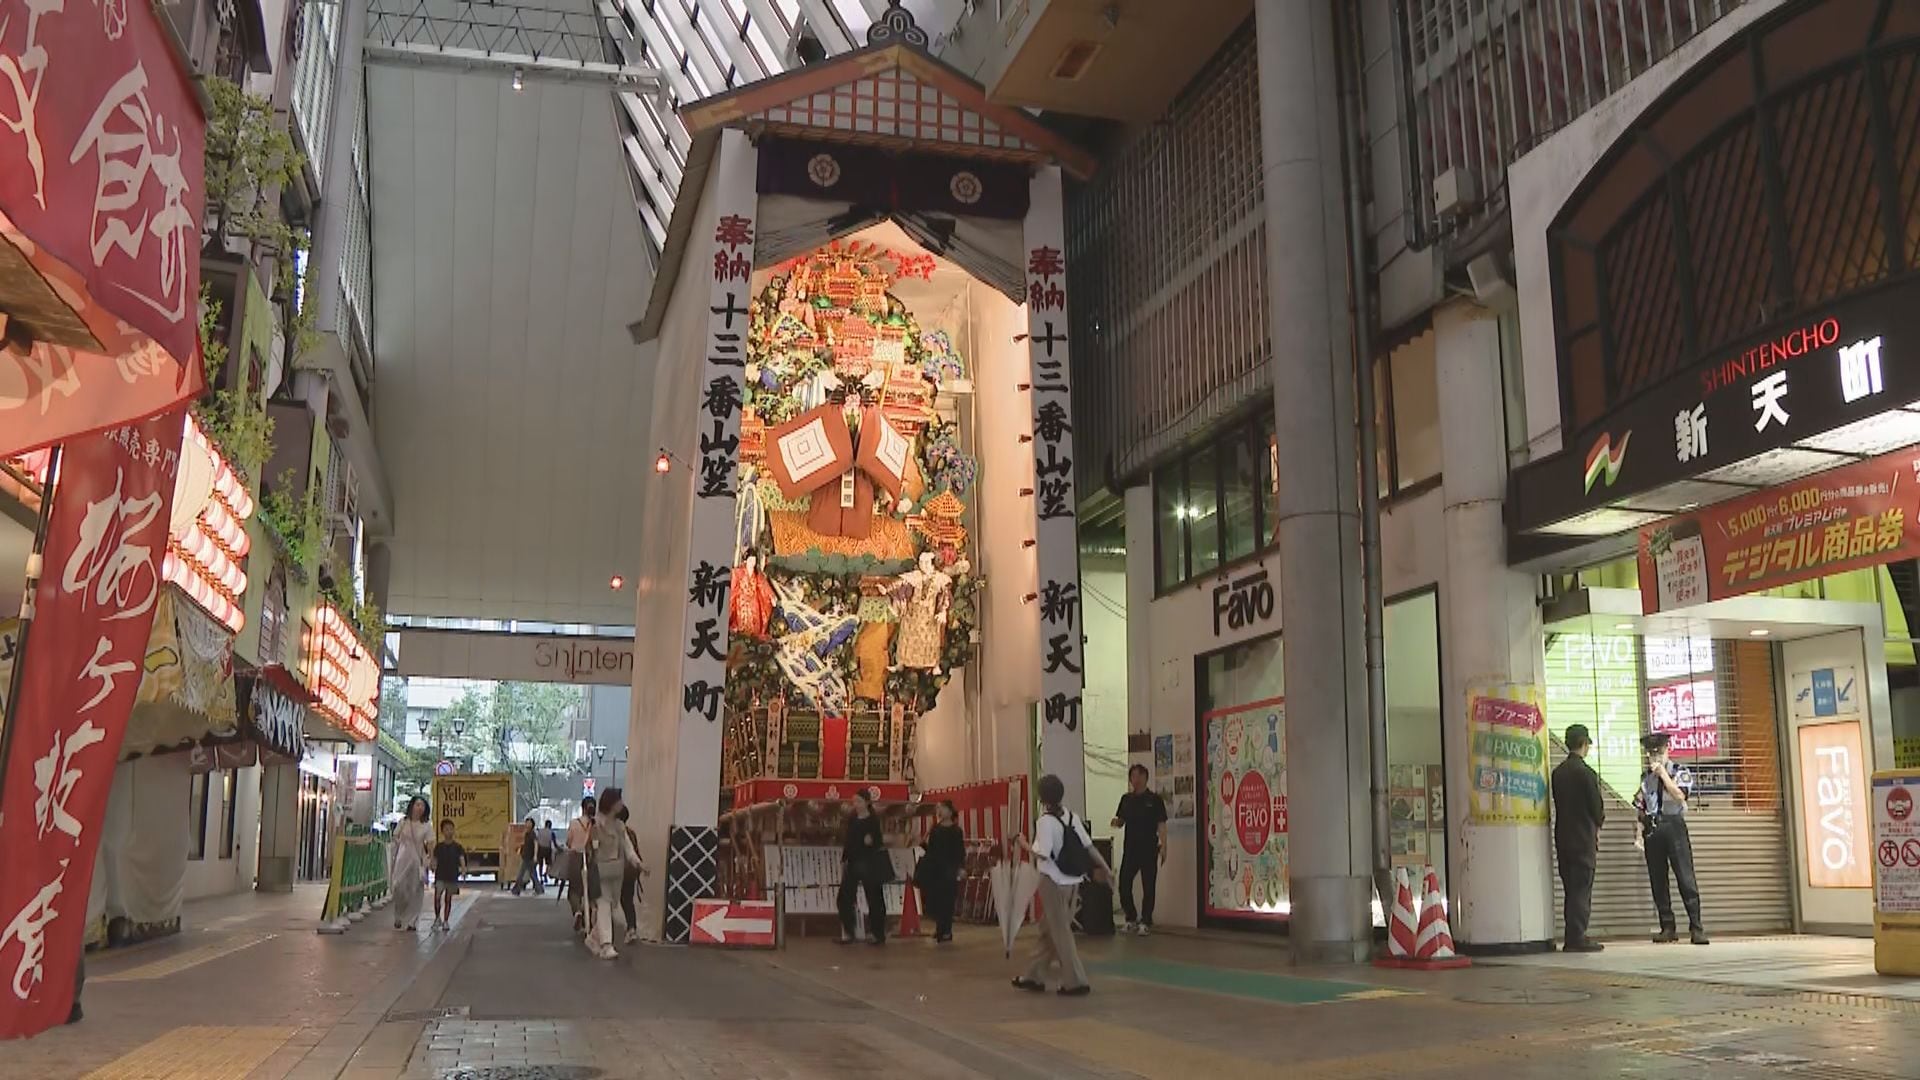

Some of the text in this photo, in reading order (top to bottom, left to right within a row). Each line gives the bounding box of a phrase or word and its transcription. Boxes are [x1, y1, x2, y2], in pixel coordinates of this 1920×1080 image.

[1702, 317, 1839, 394] SHINTENCHO
[1674, 335, 1885, 464] 新天町
[684, 214, 753, 722] 奉納 十三番山笠 新天町
[1028, 246, 1082, 732] 奉納 十三番山笠 新天町
[1722, 508, 1904, 586] デジタル商品券
[1213, 582, 1274, 637] Favo
[1563, 635, 1632, 673] Favo
[1493, 738, 1538, 760] PARCO
[442, 786, 477, 801] Yellow
[442, 802, 465, 818] Bird
[1238, 803, 1268, 828] Favo
[1815, 744, 1851, 870] Favo
